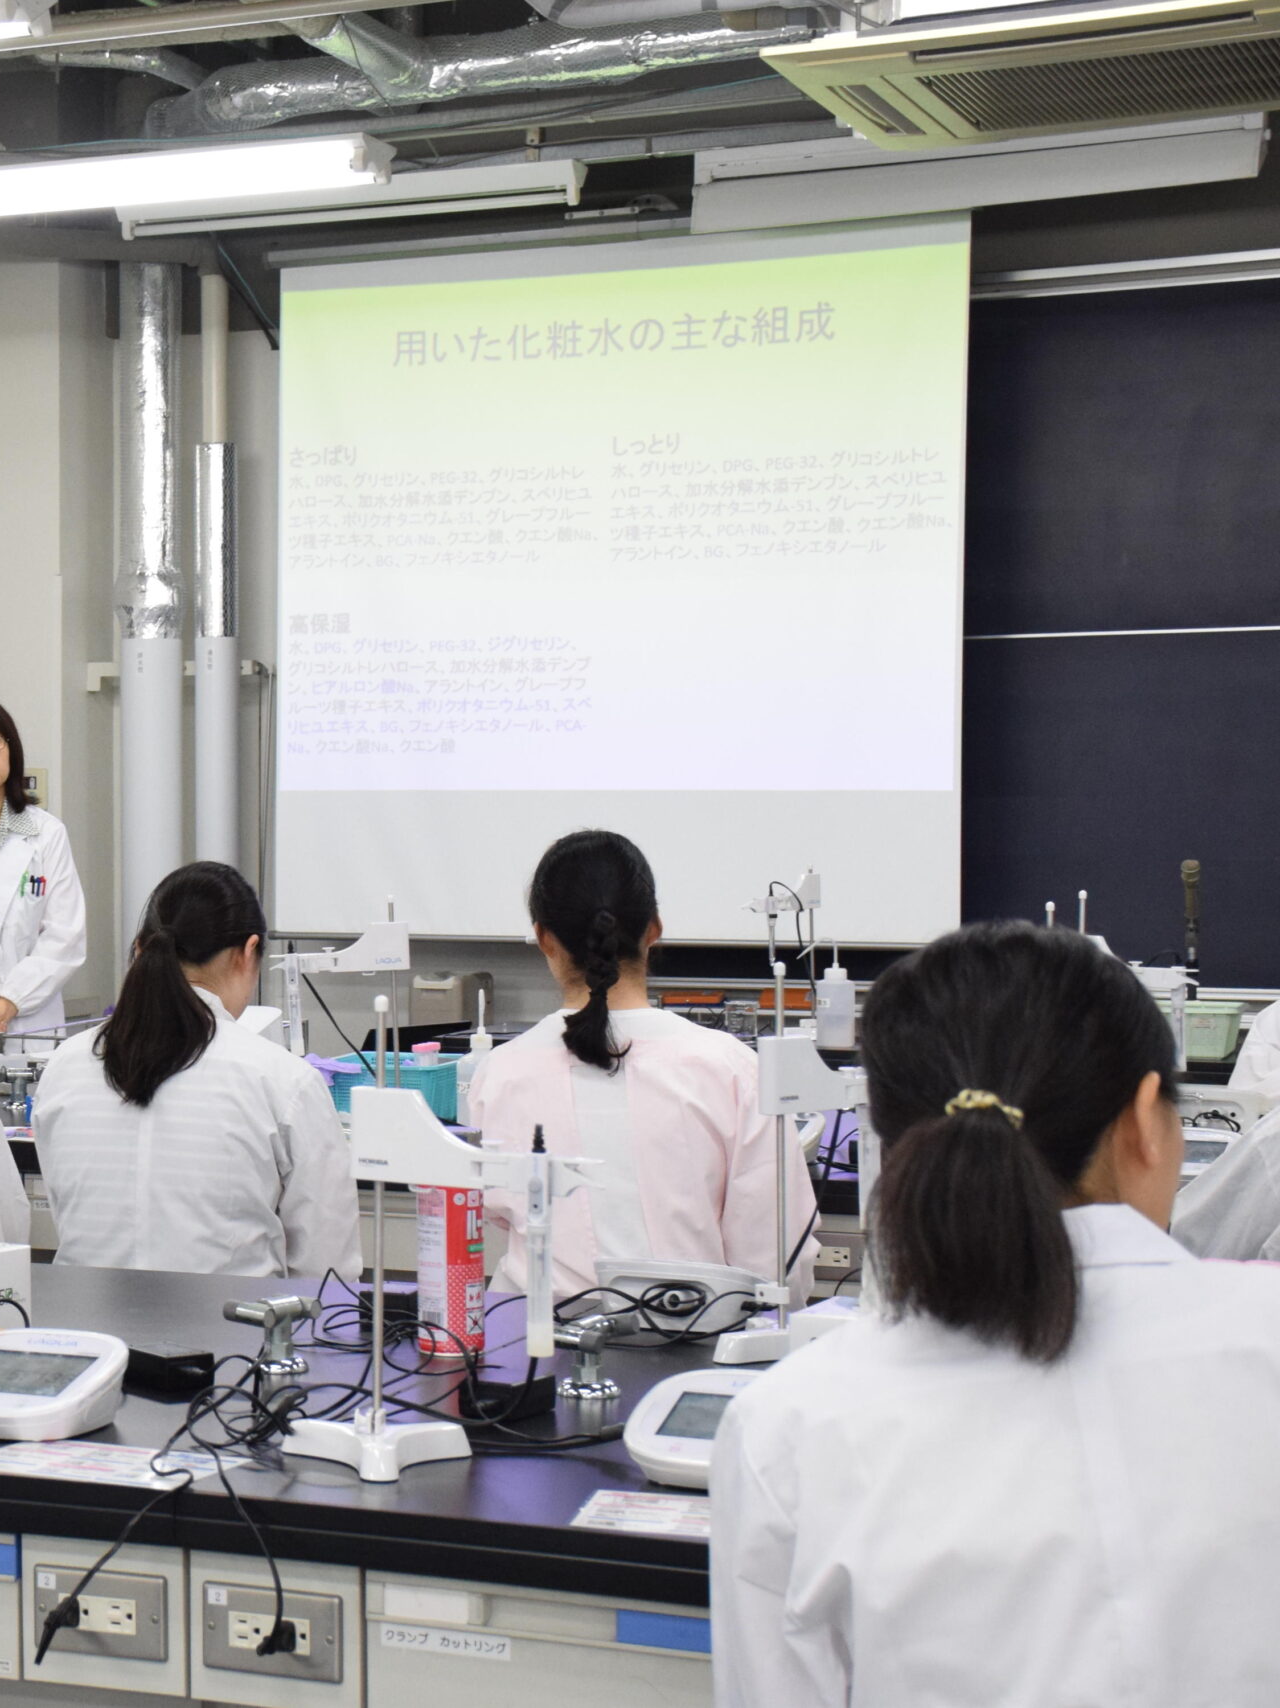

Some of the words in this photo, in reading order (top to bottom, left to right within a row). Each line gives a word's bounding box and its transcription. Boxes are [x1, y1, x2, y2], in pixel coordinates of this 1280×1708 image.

[392, 300, 836, 367] 用いた化粧水の主な組成
[611, 432, 681, 456] しっとり
[288, 445, 358, 468] さっぱり
[289, 612, 352, 635] 高保湿
